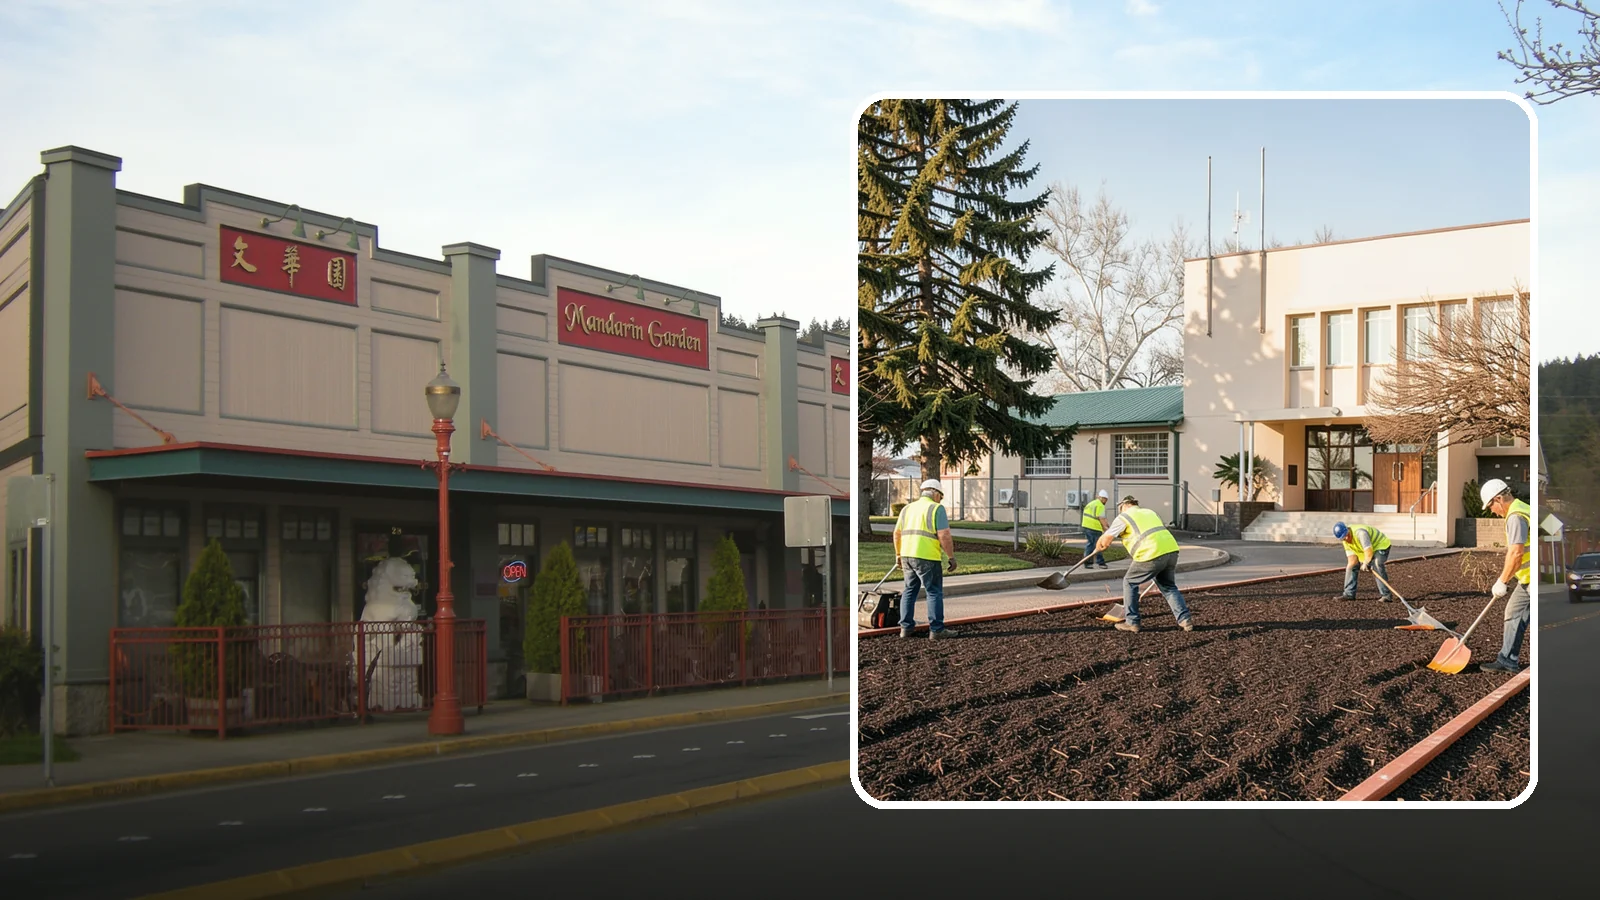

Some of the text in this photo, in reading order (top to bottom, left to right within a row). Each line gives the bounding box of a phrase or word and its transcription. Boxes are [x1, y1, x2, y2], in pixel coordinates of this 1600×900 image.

[231, 236, 345, 290] 文華園
[564, 302, 702, 352] Mandarin Garden
[834, 363, 847, 386] 文
[503, 565, 527, 578] OPEN
